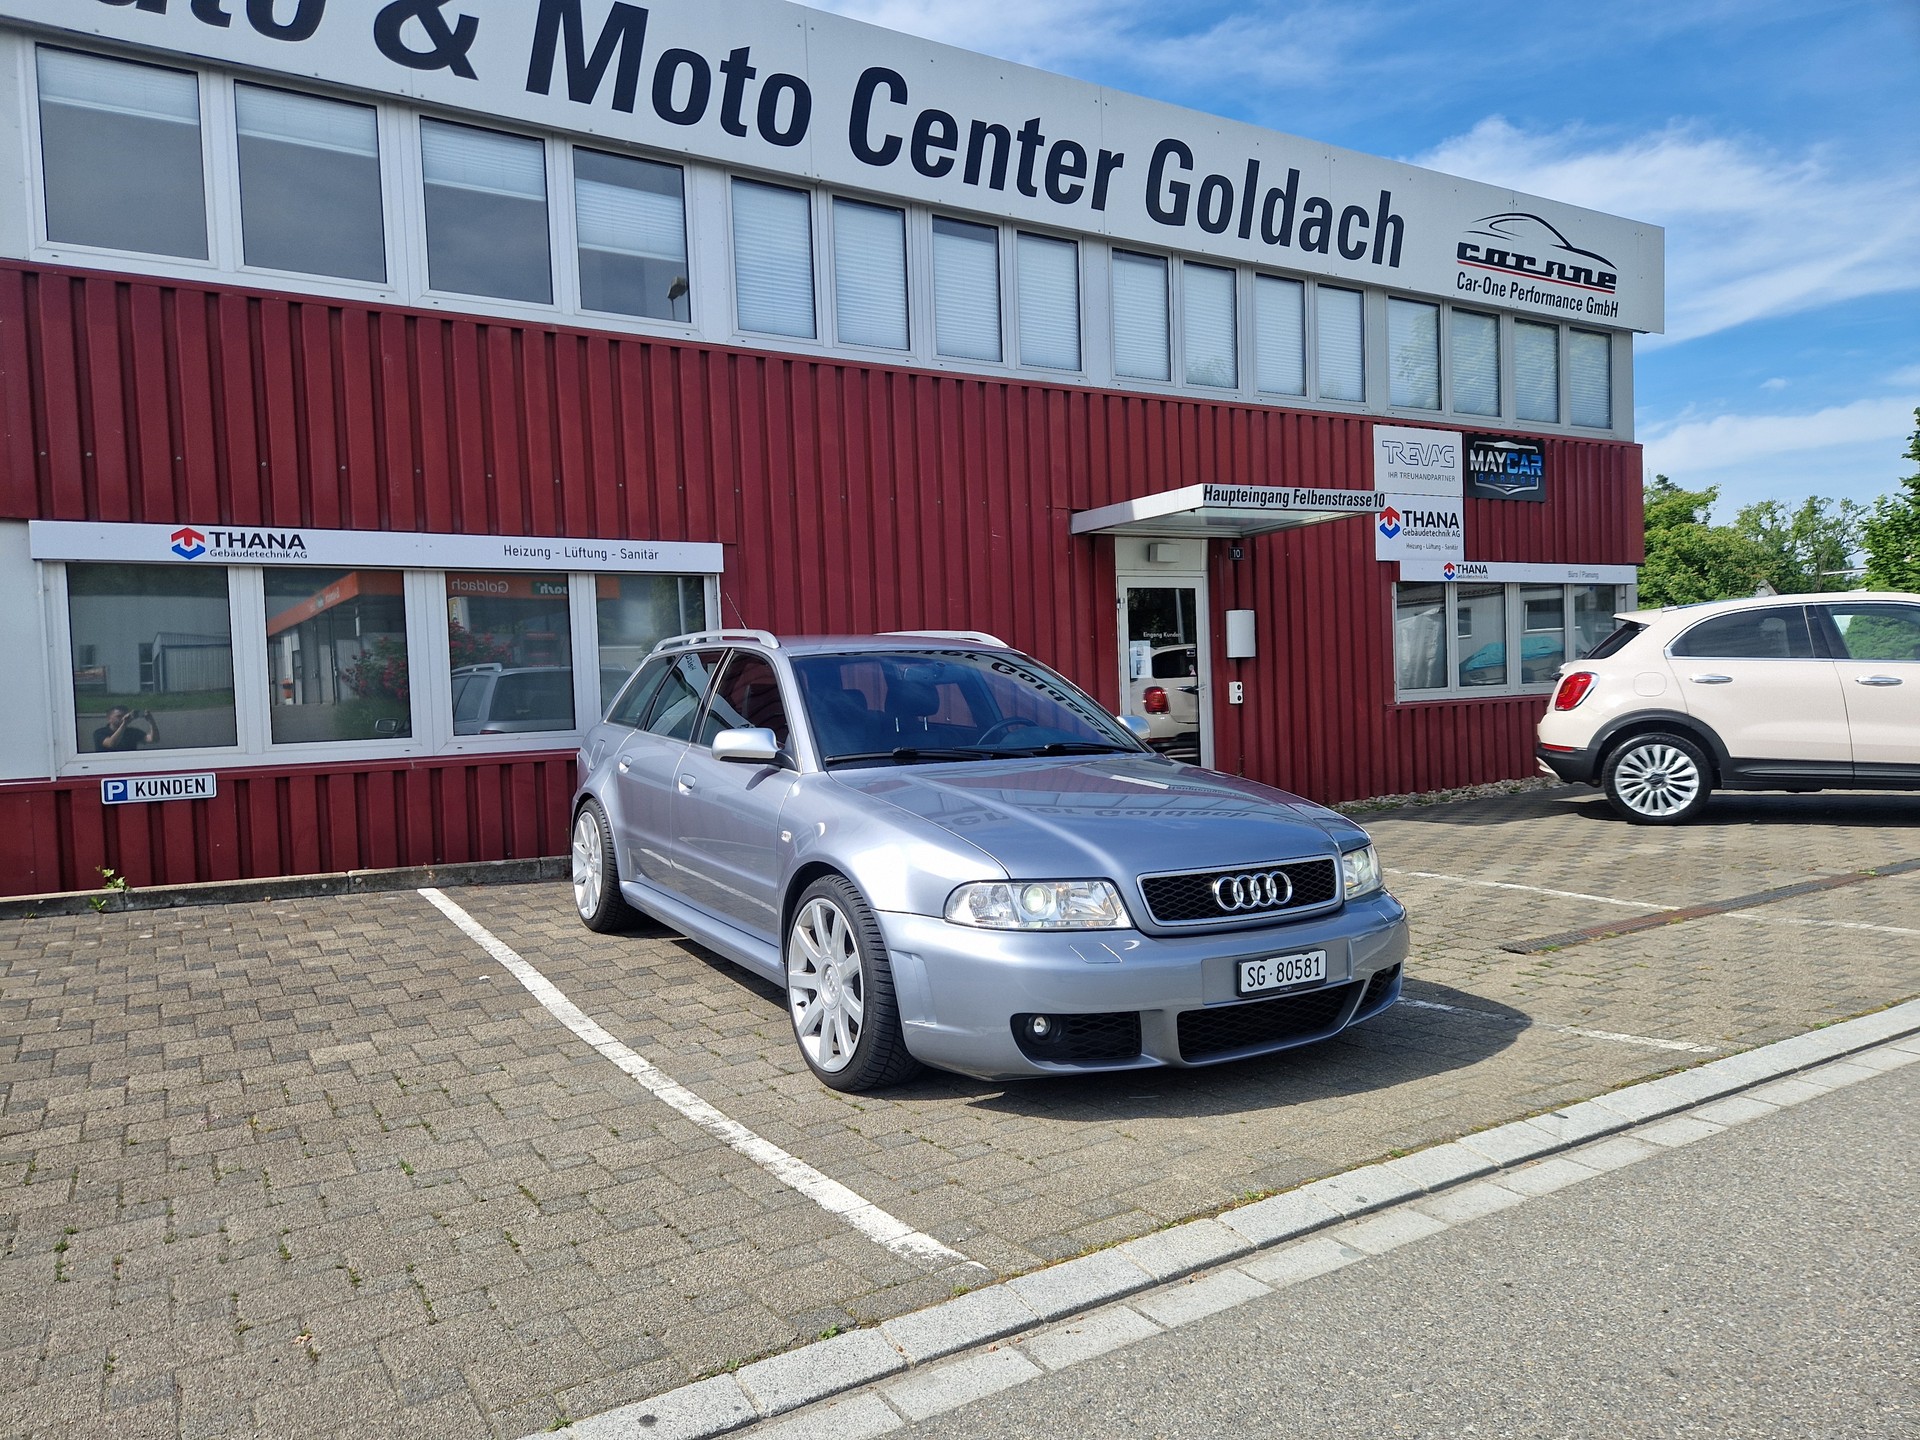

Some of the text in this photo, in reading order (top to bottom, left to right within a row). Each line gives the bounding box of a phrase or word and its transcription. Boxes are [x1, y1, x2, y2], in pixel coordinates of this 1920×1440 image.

[373, 0, 1405, 269] & Moto Center Goldach
[1456, 271, 1619, 318] Car-One Performance GmbH
[1381, 440, 1455, 469] TREVAG
[1400, 472, 1456, 482] TREUHANDPARTNER
[1203, 484, 1290, 508] Haupteingang
[1402, 510, 1460, 529] THANA
[209, 531, 306, 550] THANA
[1402, 528, 1461, 538] Gebäudetechnik AG
[209, 549, 308, 559] Gebäudetechnik AG
[503, 544, 551, 560] Heizung
[564, 546, 608, 562] Lüftung
[620, 547, 659, 560] Sanitär
[1232, 549, 1241, 558] 10
[1456, 564, 1488, 574] THANA
[135, 778, 206, 797] KUNDEN
[1247, 956, 1321, 988] SG 80581
